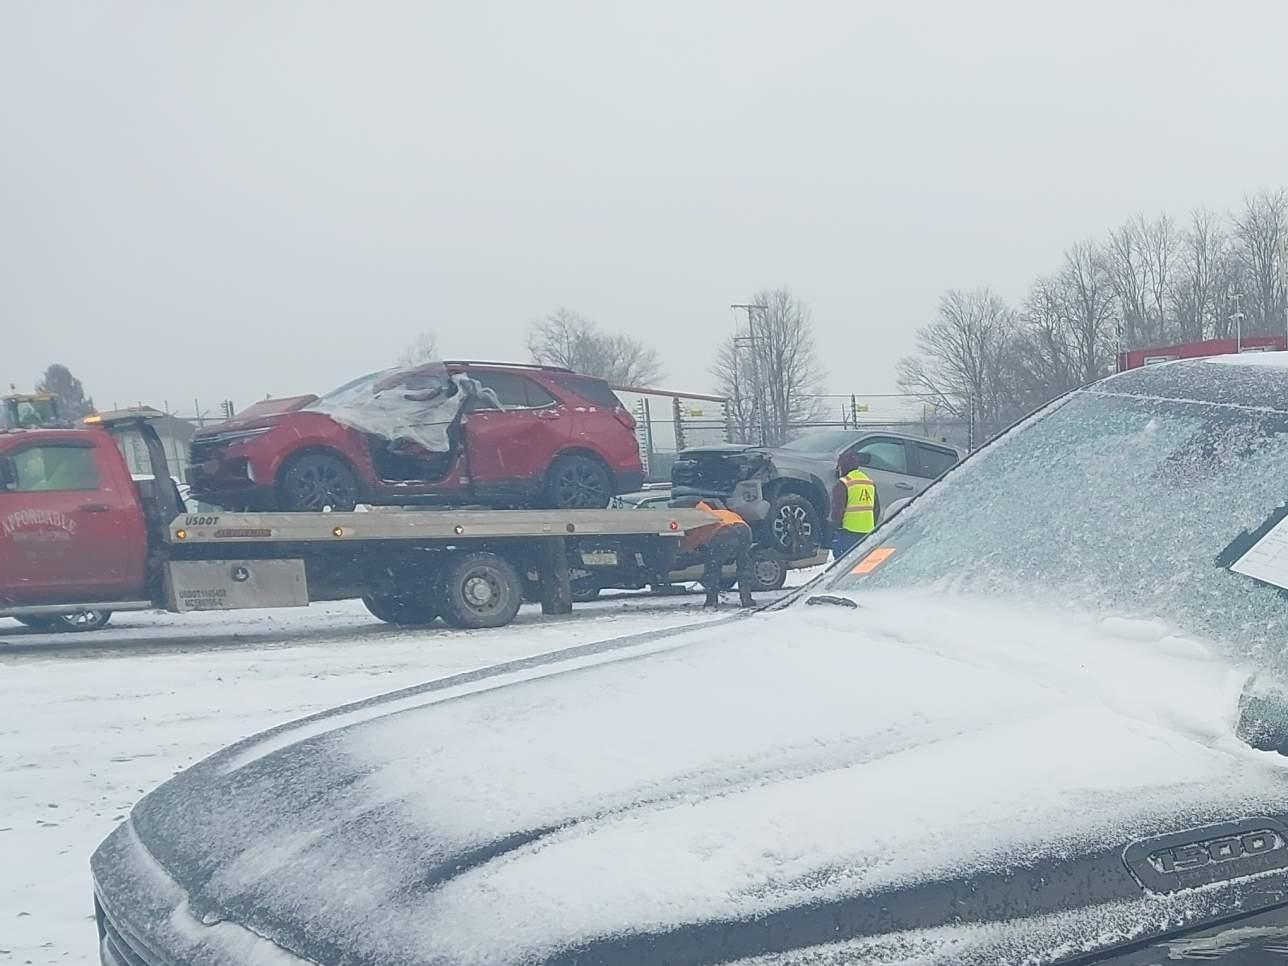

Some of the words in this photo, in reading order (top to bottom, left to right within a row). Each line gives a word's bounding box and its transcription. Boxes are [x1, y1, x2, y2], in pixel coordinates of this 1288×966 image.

[1, 509, 77, 537] AFFORDABLE
[185, 516, 220, 526] USDOT
[1154, 831, 1277, 872] 1500
